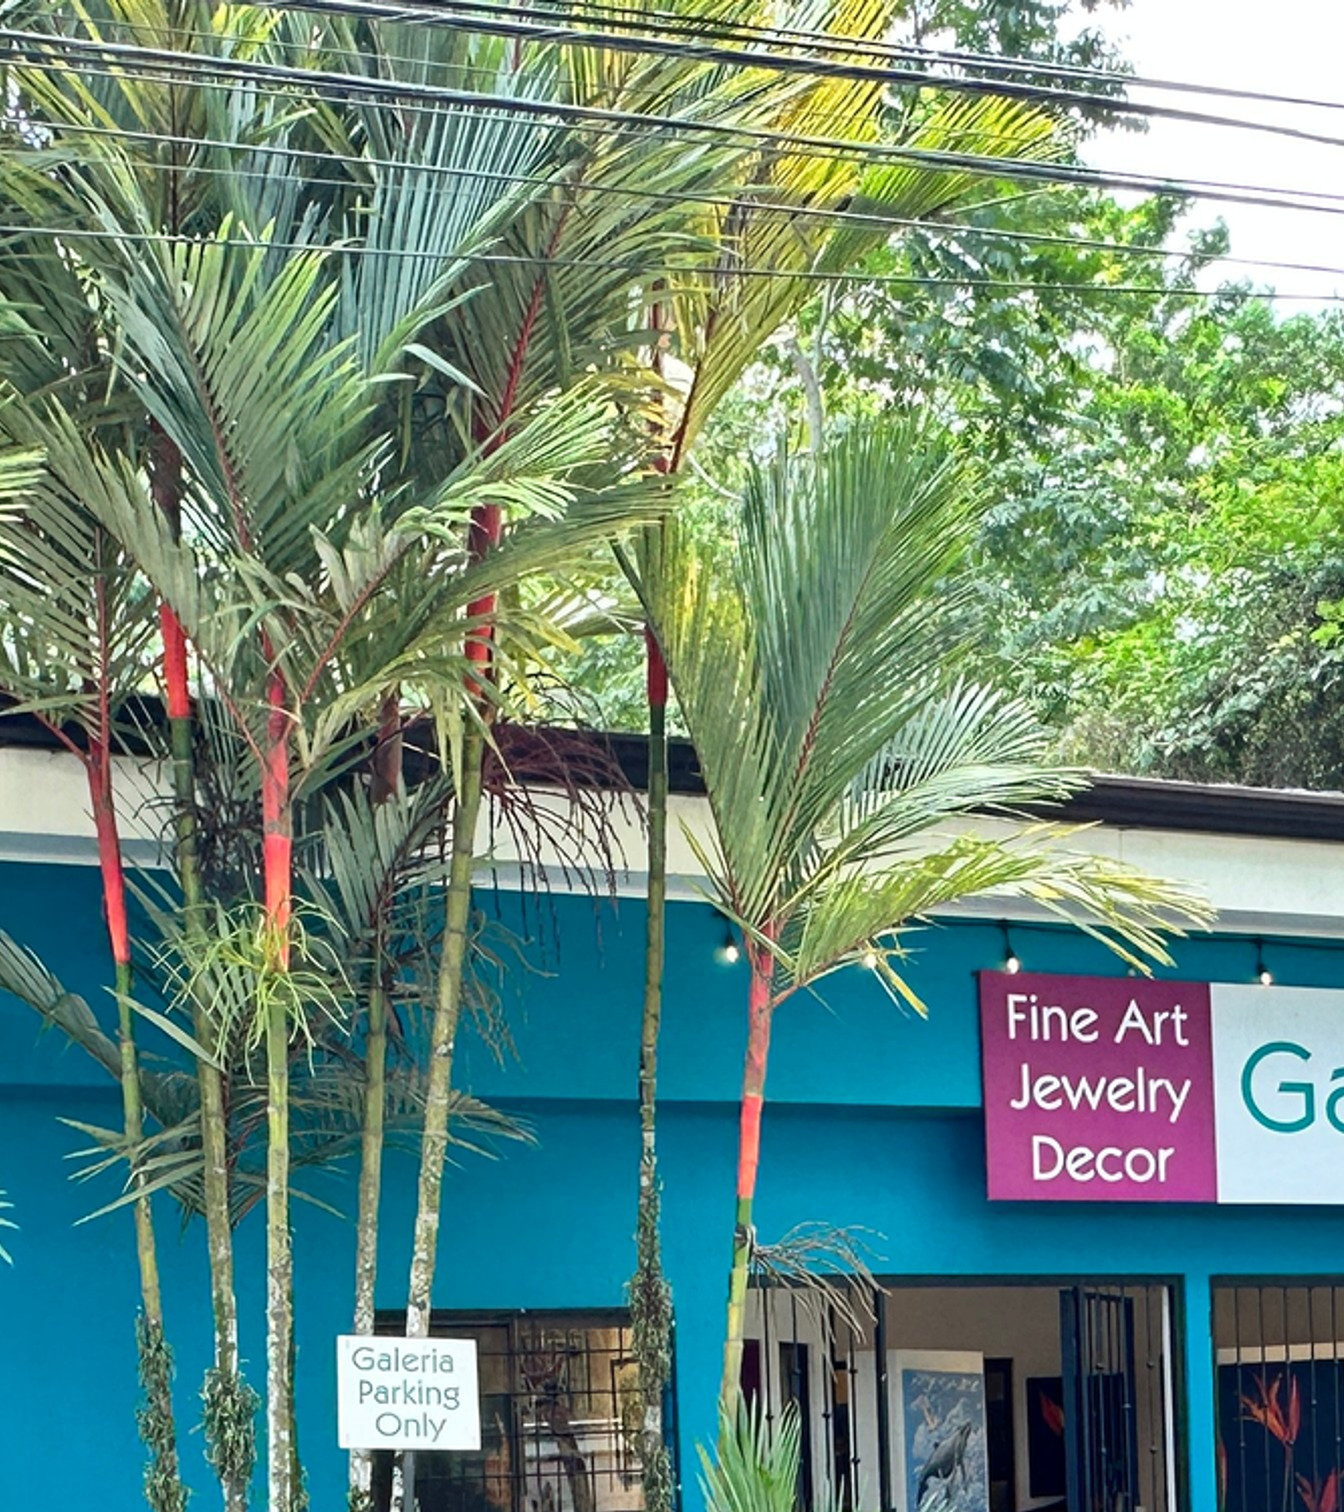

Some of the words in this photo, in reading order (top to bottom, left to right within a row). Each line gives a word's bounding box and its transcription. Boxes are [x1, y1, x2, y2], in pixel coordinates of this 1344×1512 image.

[1006, 993, 1100, 1043] Fine
[1113, 998, 1190, 1047] Art
[1009, 1062, 1192, 1124] Jewelry
[1031, 1134, 1175, 1183] Decor
[351, 1346, 454, 1373] Galeria
[358, 1379, 460, 1411] Parking
[375, 1411, 447, 1443] Only
